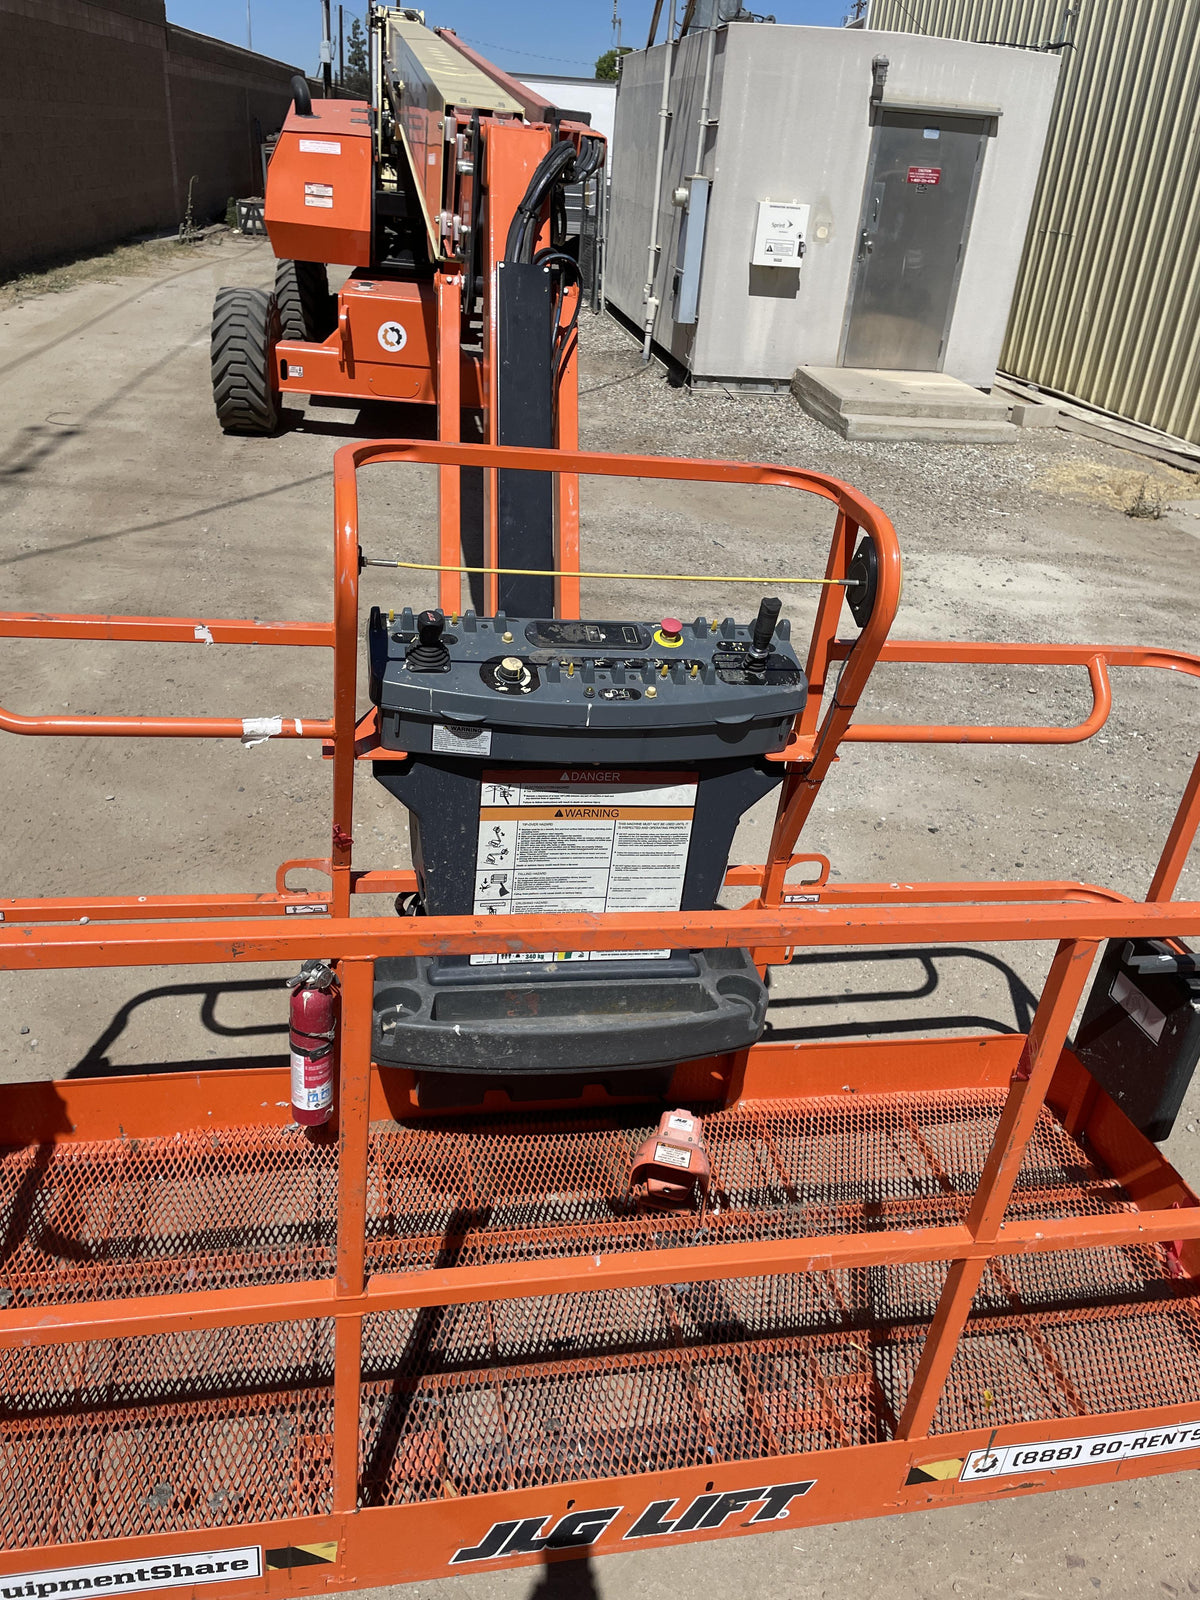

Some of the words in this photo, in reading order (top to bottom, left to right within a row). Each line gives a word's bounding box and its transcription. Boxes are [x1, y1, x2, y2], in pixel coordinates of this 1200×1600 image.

[571, 772, 620, 781] DANGER
[565, 809, 620, 818] WARNING
[1011, 1446, 1083, 1467] (888)
[1090, 1428, 1200, 1456] 80-RENTS
[448, 1506, 624, 1565] JLG
[622, 1480, 818, 1540] LIFT
[1, 1557, 250, 1599] uipmentShare
